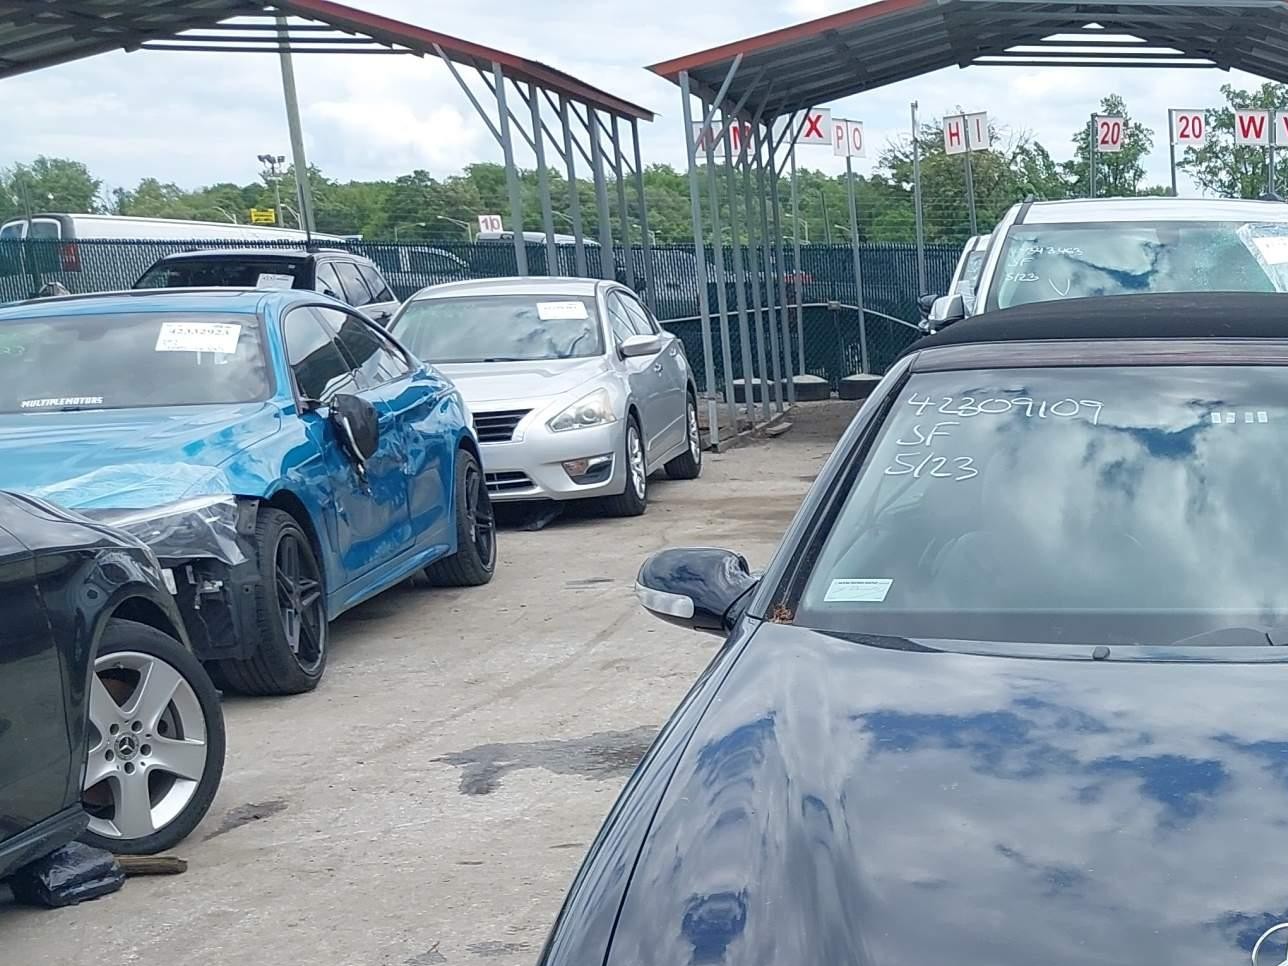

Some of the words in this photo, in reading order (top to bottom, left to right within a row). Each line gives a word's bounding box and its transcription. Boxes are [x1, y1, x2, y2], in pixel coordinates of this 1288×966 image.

[804, 115, 824, 138] X
[836, 125, 844, 149] P
[948, 121, 961, 146] H
[1100, 122, 1120, 145] 20
[1179, 116, 1202, 139] 20
[1238, 115, 1265, 139] W
[907, 392, 1104, 425] 42309109
[884, 452, 978, 481] 5/23
